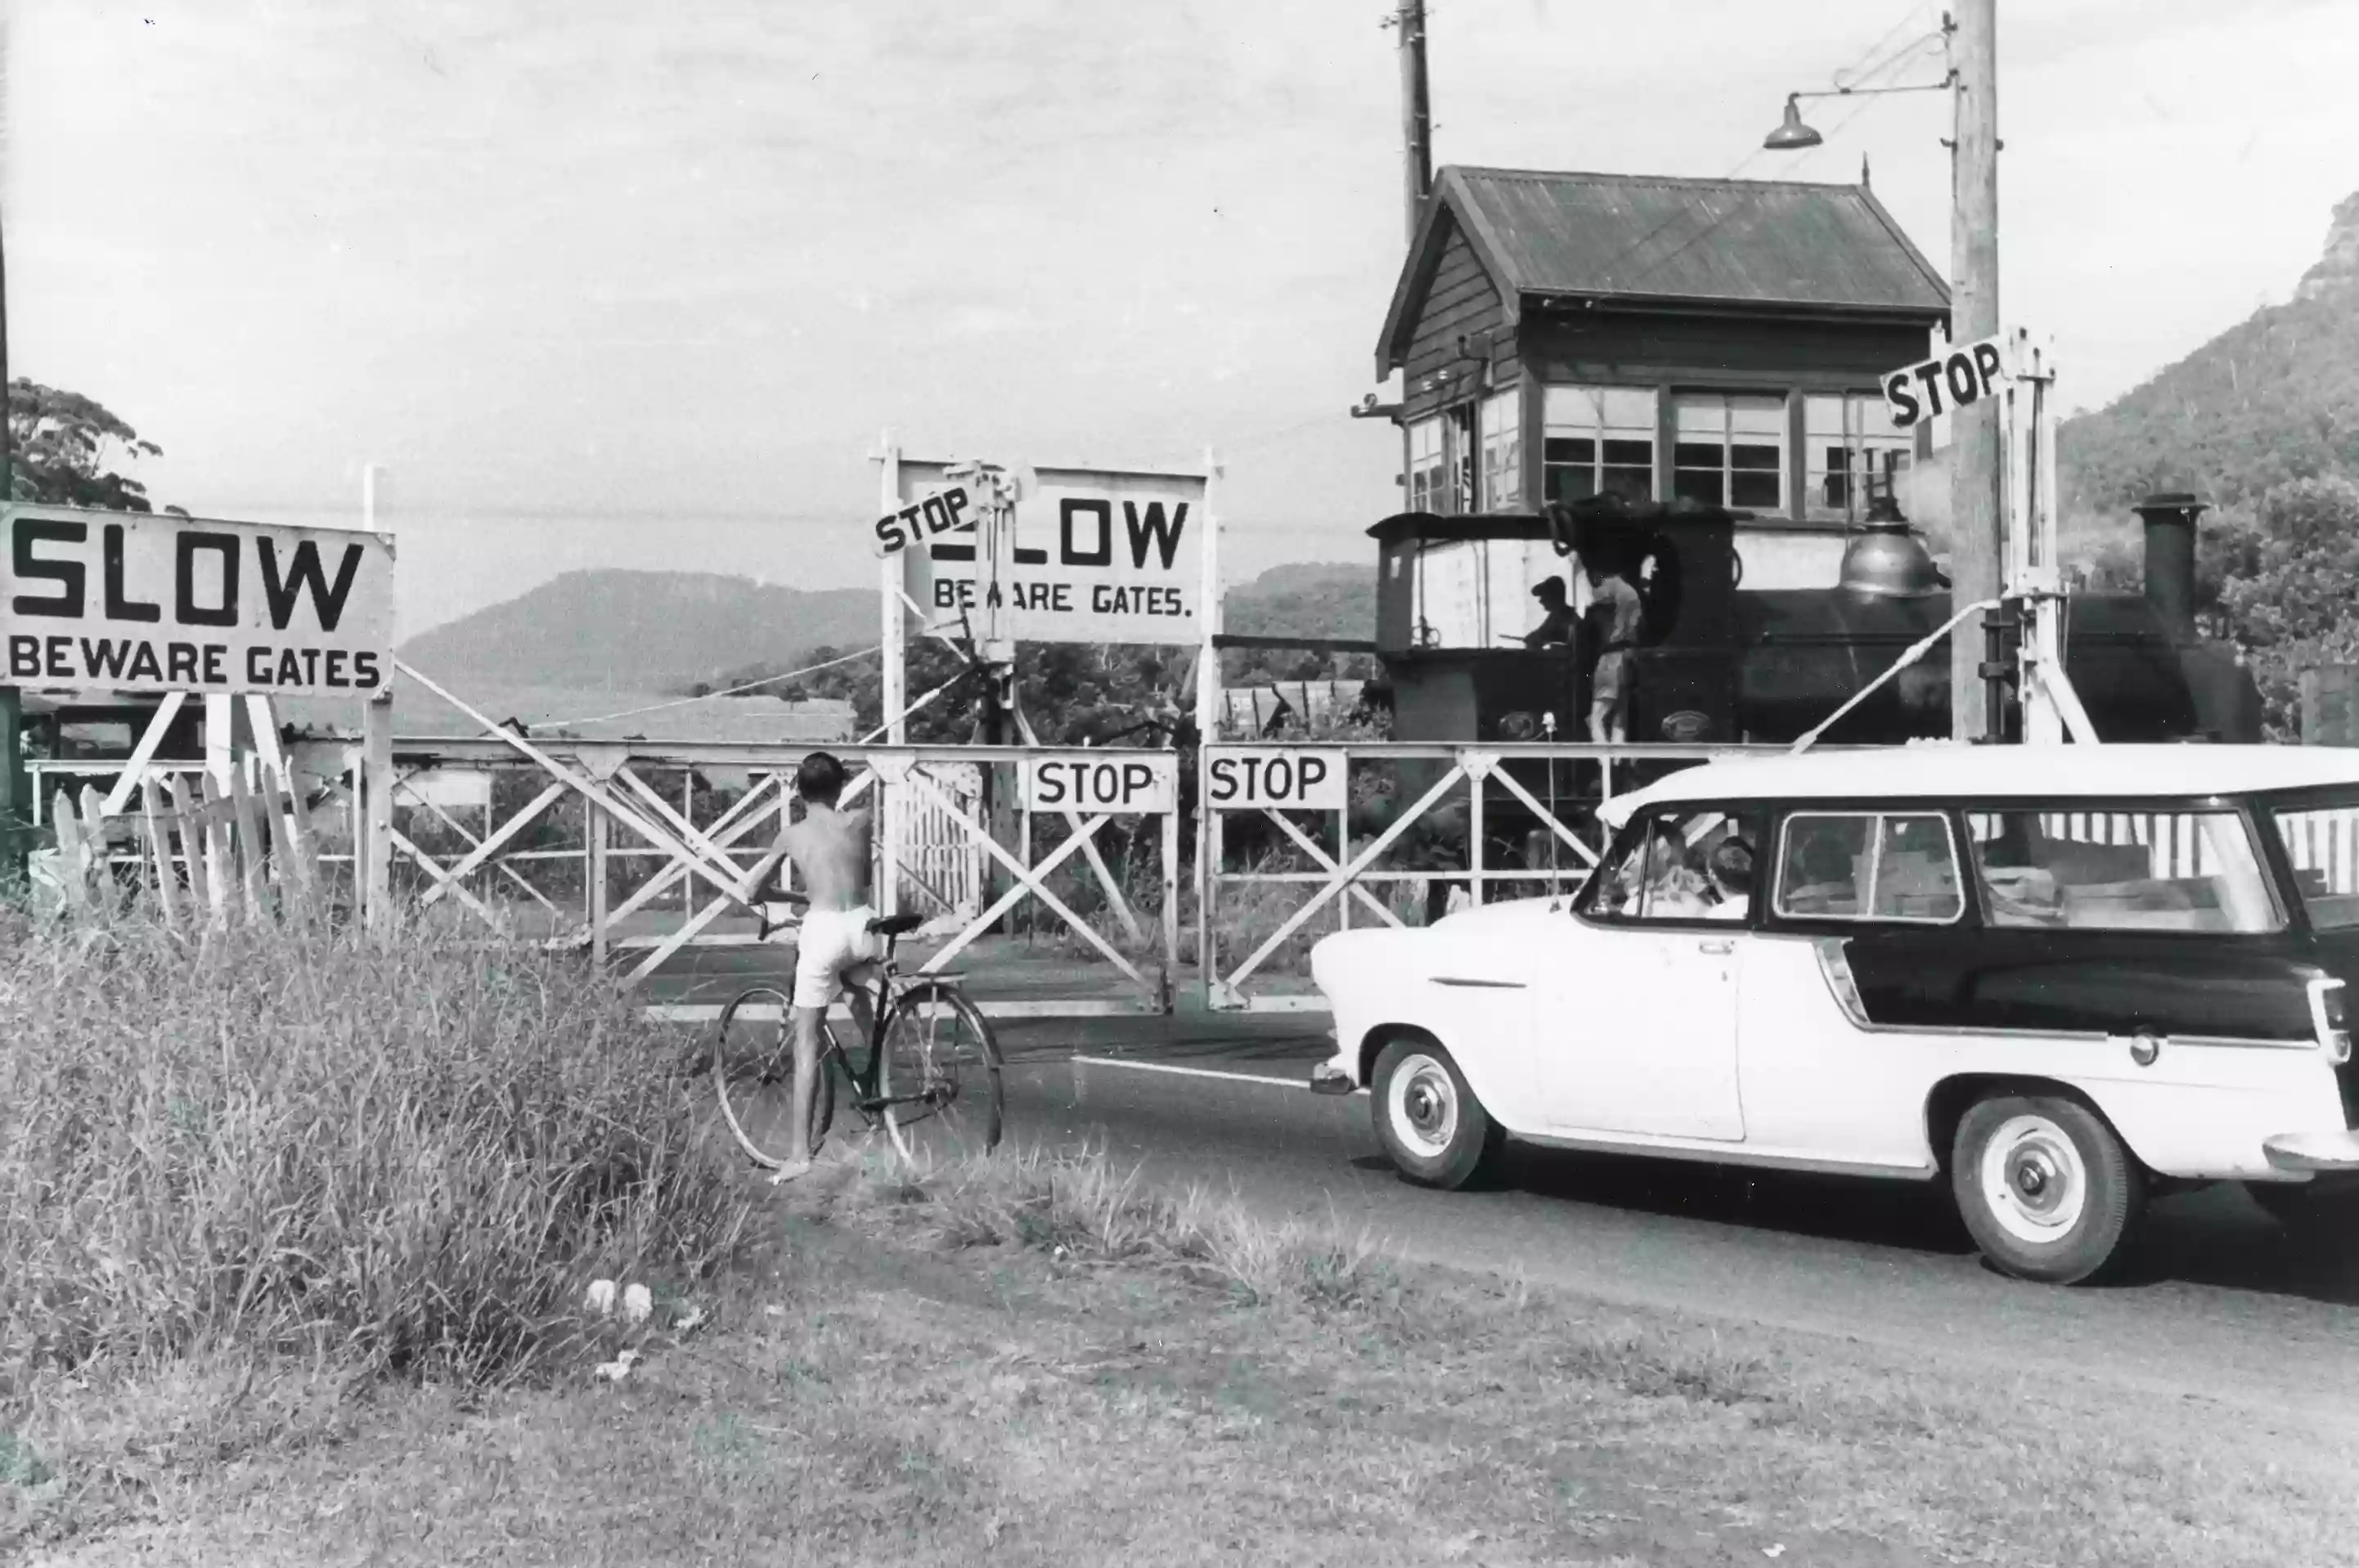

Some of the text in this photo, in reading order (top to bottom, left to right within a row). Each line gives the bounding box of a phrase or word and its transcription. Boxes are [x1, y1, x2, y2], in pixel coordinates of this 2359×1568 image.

[1888, 343, 2000, 428] STOP
[875, 487, 968, 553] STOP
[931, 498, 1189, 569] LOW
[12, 518, 365, 631] SLOW
[1093, 585, 1193, 618] GATES.
[9, 635, 380, 688] BEWARE GATES
[1037, 762, 1153, 804] STOP
[1211, 757, 1327, 801] STOP
